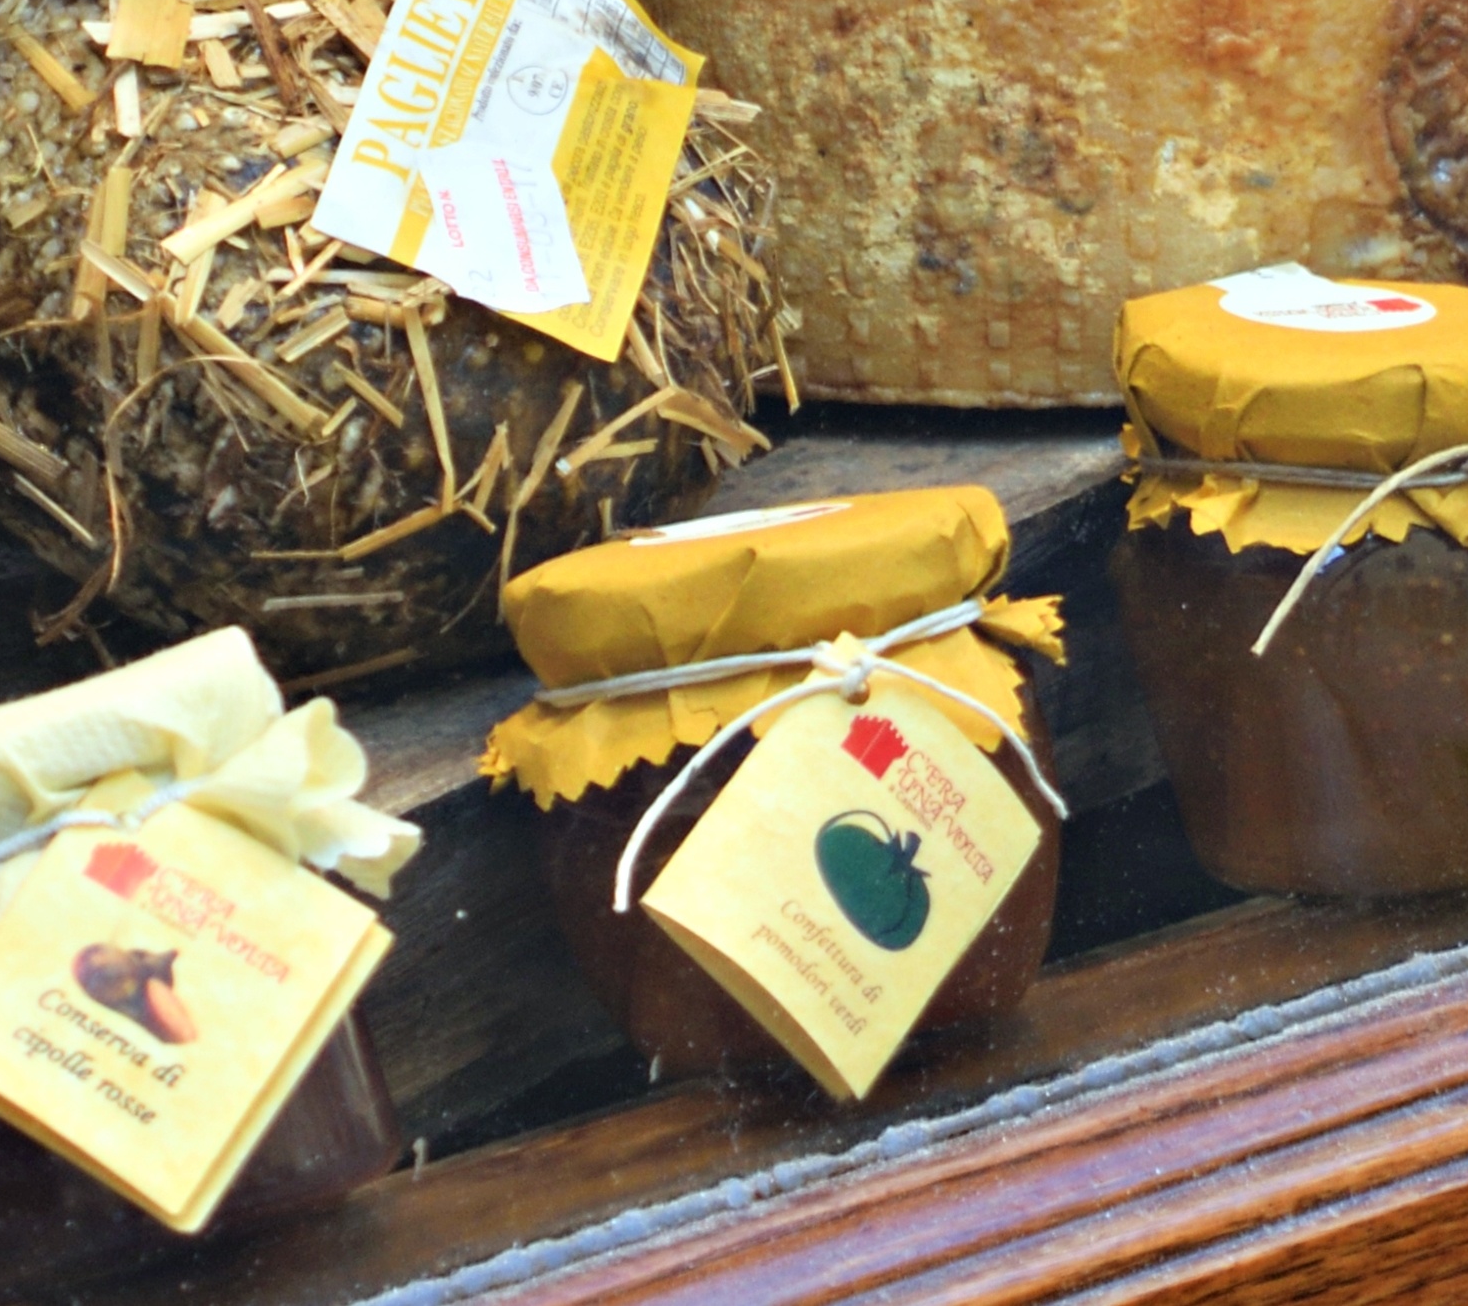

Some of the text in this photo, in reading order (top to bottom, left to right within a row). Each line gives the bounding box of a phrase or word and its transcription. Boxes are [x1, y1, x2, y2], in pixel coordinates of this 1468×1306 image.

[442, 202, 464, 248] LOTTO
[588, 260, 606, 287] non
[586, 263, 626, 337] Conservare
[619, 224, 640, 252] luogo
[889, 767, 1000, 885] UNA VOLTA
[902, 748, 970, 815] C'ERA
[751, 922, 869, 1038] pomodori verdi
[777, 897, 886, 1005] Confettura di
[10, 1021, 158, 1126] cipolle rosse
[36, 985, 186, 1090] Conserva di
